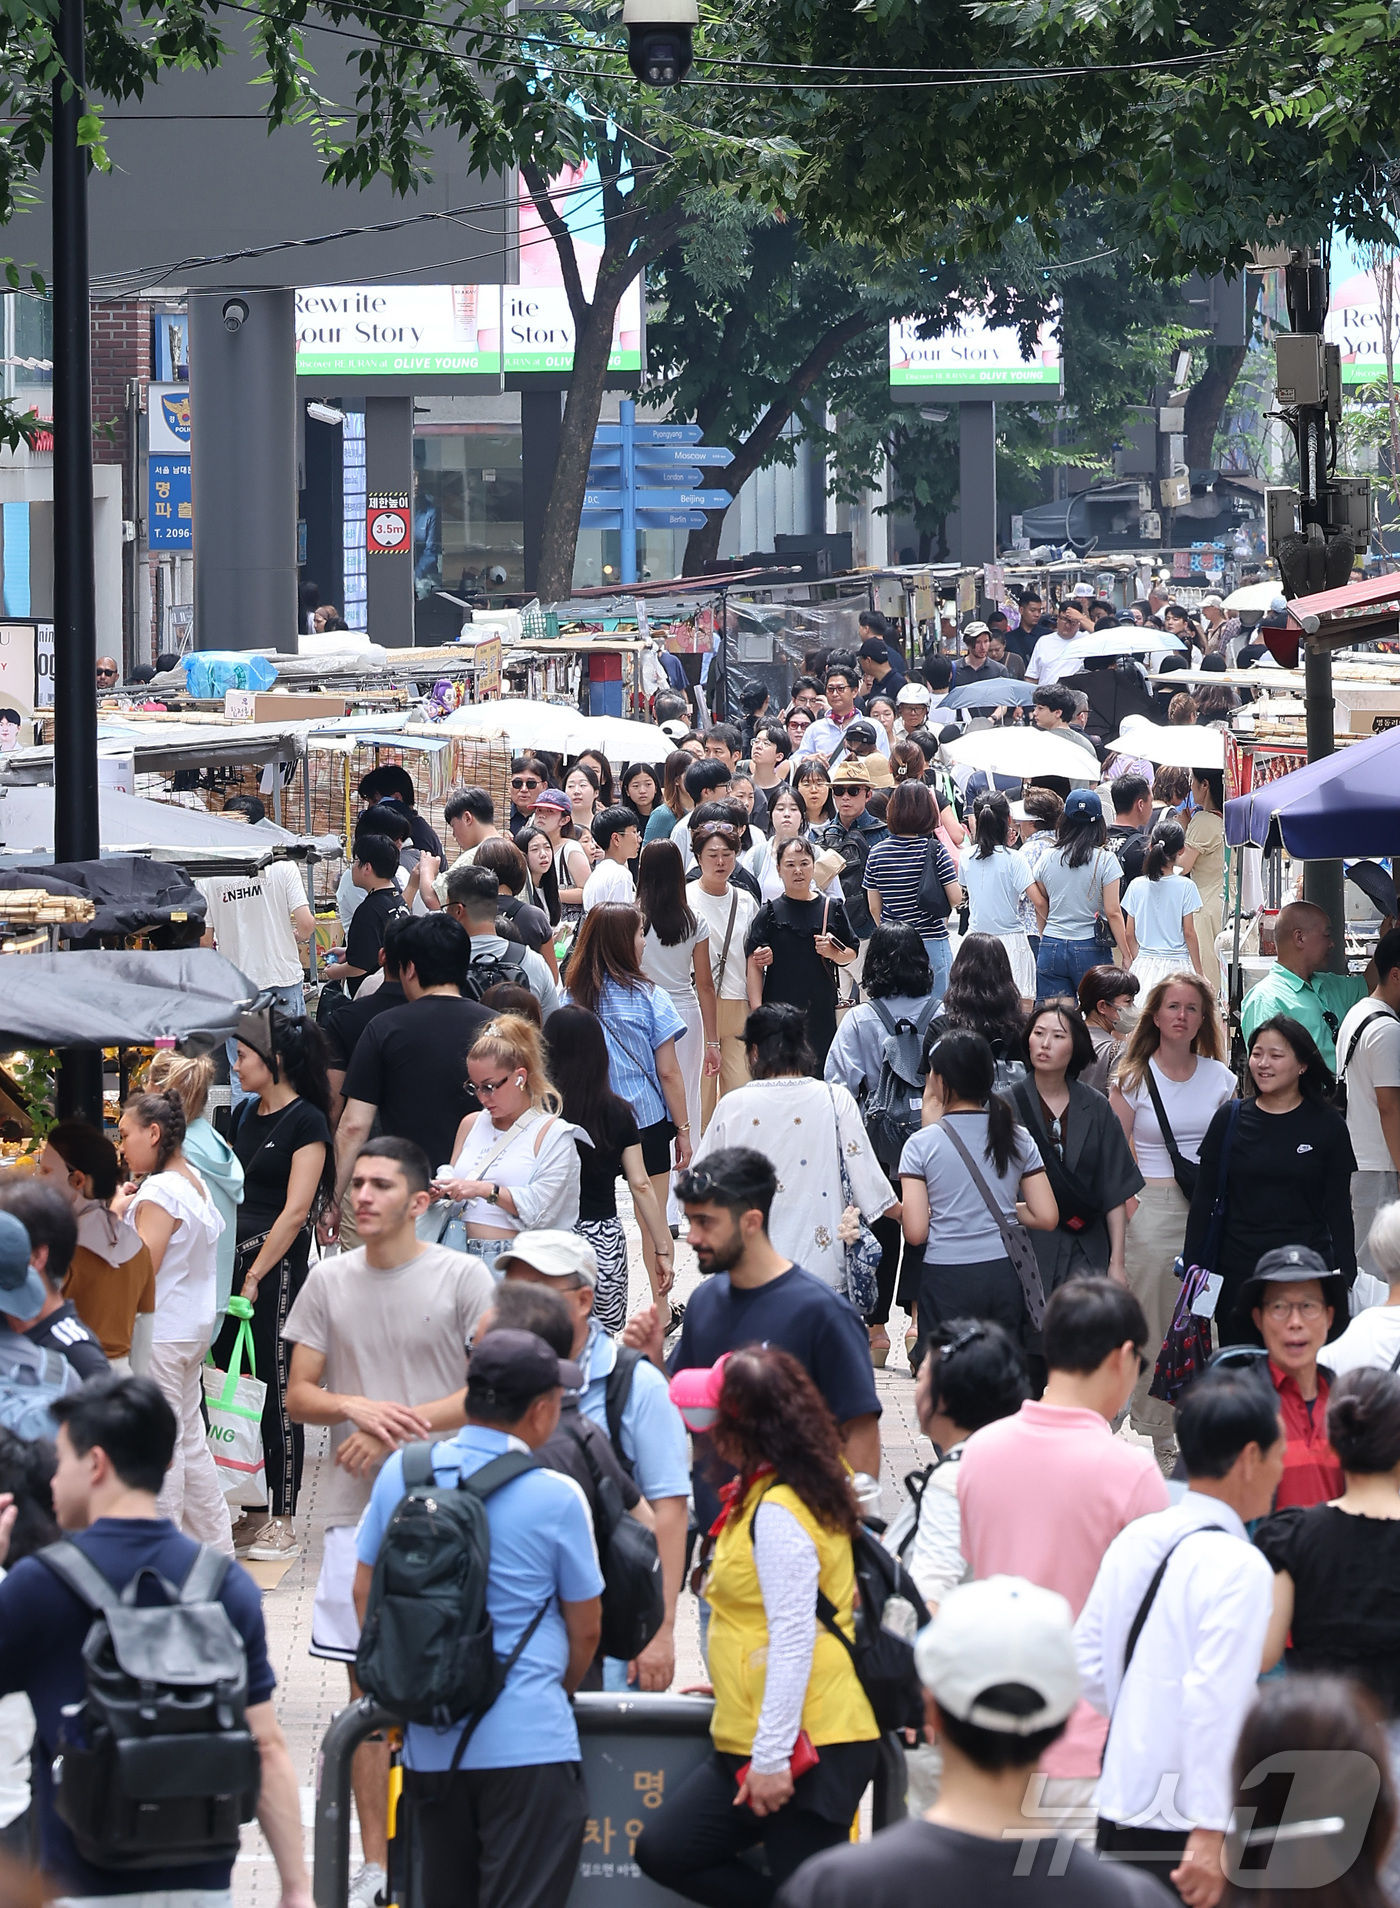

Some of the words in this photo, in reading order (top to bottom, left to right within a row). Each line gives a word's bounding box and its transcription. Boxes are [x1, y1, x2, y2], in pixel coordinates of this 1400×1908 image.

[296, 293, 387, 314] Rewrite
[503, 298, 539, 318] ite
[296, 323, 344, 344] our
[355, 321, 425, 349] Story
[511, 325, 573, 349] Story
[900, 345, 941, 362] Your
[951, 345, 1000, 365] Story
[296, 360, 332, 369] Discover
[334, 360, 377, 368] REJURAN
[379, 360, 388, 368] at
[394, 358, 431, 369] OLIVE
[435, 358, 480, 369] YOUNG
[545, 356, 573, 367] OLIV
[979, 371, 1007, 380] OLIVE
[1010, 371, 1044, 380] YOUNG
[652, 430, 683, 439] Pyongyang
[675, 451, 706, 460] Moscow
[155, 466, 170, 475] 서울
[663, 473, 684, 481] London
[368, 496, 408, 509] 제한높이
[680, 494, 705, 504] Beijing
[669, 515, 687, 523] Berlin
[154, 529, 163, 538] T.
[376, 524, 404, 534] 3.5m
[222, 884, 263, 904] WHEN?
